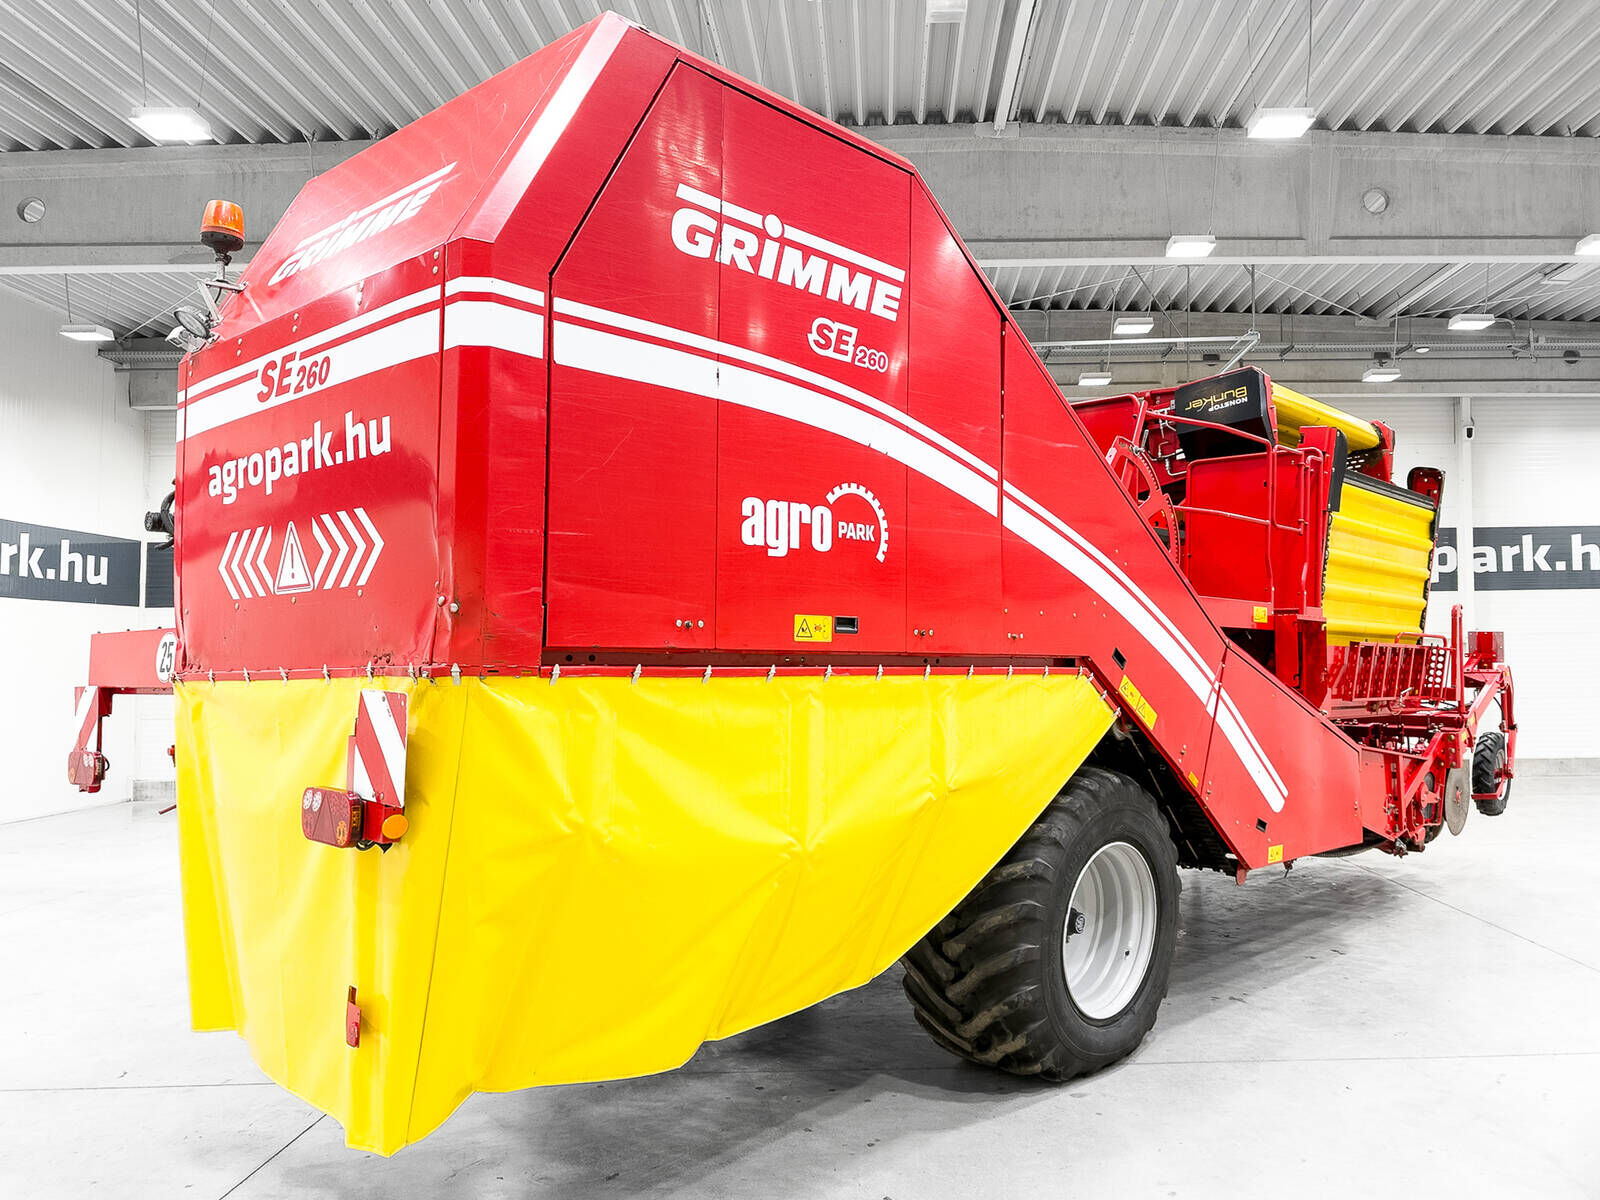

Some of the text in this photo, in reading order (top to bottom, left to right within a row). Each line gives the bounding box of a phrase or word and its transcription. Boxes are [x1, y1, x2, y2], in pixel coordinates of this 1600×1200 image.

[268, 180, 443, 286] GRIMME
[671, 207, 902, 322] GRIMME
[809, 319, 887, 372] SE 260
[257, 352, 331, 403] SE 260
[1185, 386, 1247, 412] Bunker
[1208, 397, 1248, 412] NONSTOP
[208, 410, 391, 505] agropark.hu
[741, 496, 875, 557] agro PARK
[160, 641, 174, 673] 25
